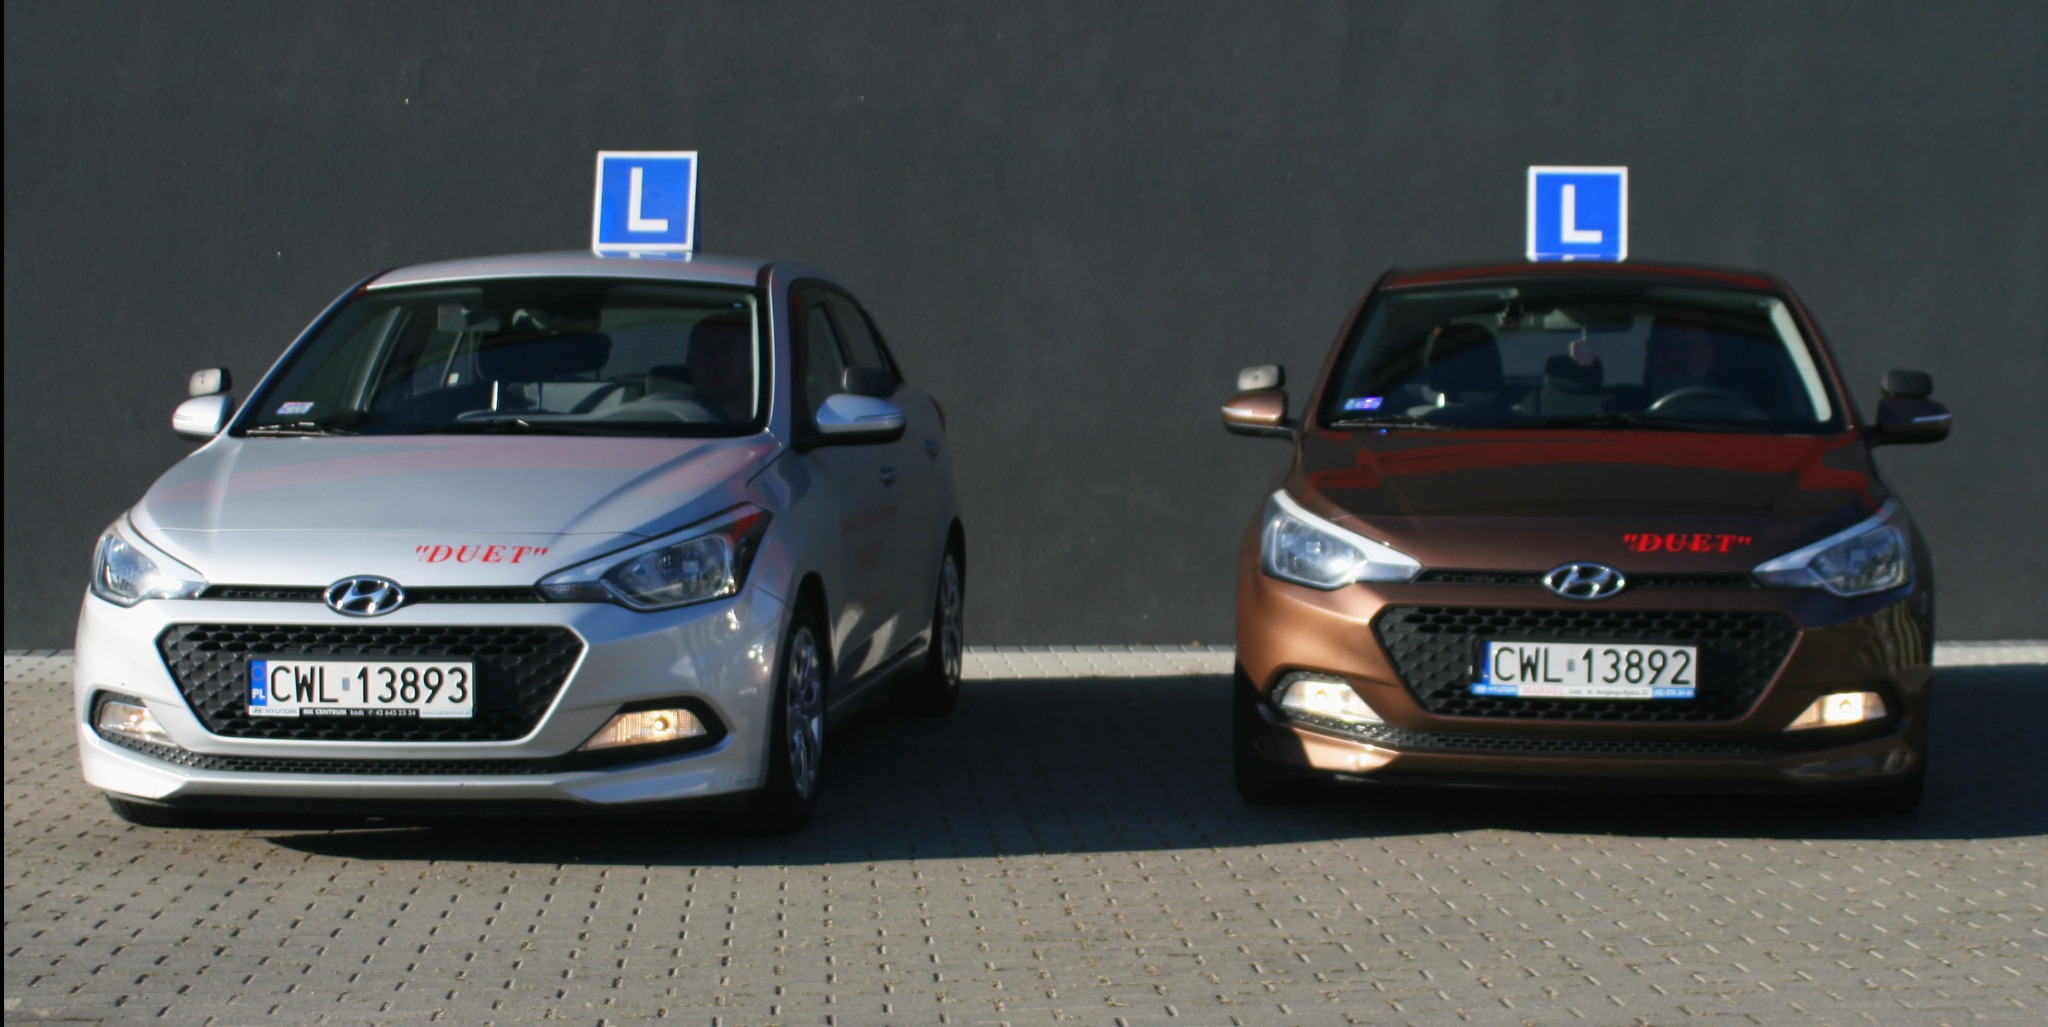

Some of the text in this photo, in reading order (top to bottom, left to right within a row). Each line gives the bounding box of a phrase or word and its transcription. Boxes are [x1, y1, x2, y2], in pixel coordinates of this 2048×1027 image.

[628, 167, 668, 231] L
[1561, 184, 1602, 243] L
[415, 544, 549, 563] "DUET"
[1622, 532, 1752, 553] "DUET"
[270, 665, 468, 704] CWL 13893
[1495, 646, 1691, 685] CWL 13892
[252, 688, 265, 699] PL
